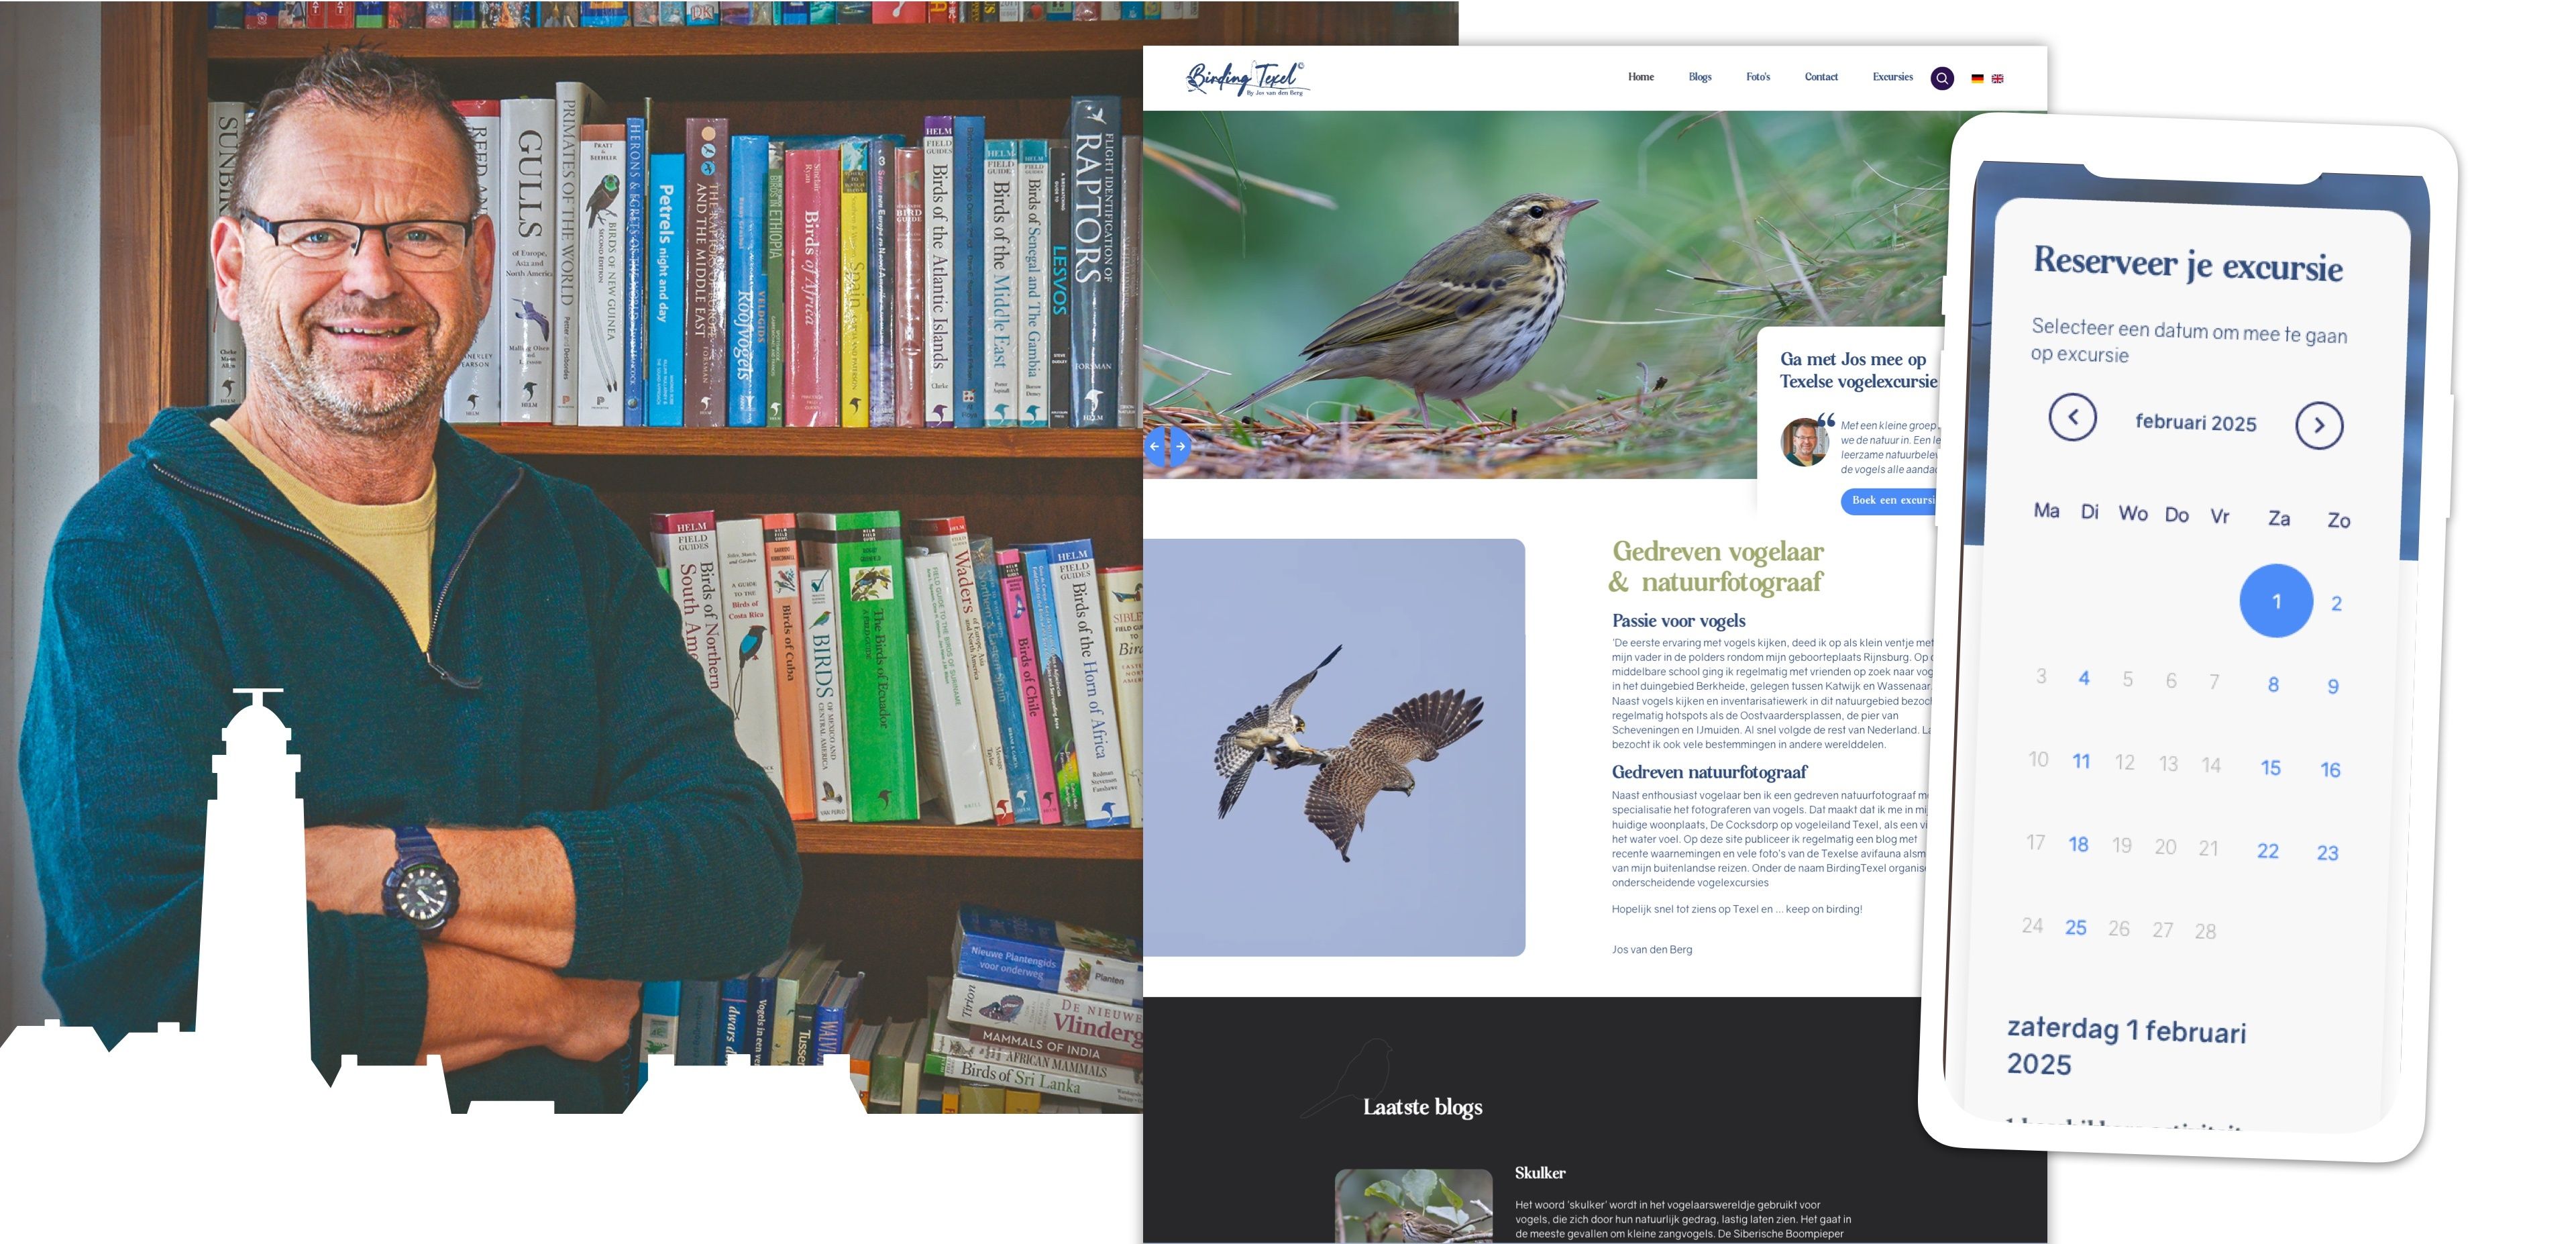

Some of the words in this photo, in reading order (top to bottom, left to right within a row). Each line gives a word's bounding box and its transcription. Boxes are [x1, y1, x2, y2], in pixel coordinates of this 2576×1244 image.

[1189, 62, 1252, 97] Birding
[1255, 62, 1297, 87] Texel
[1628, 72, 1655, 81] Home
[1689, 71, 1712, 84] Blogs
[1746, 71, 1771, 81] Foto's
[1805, 72, 1839, 81] Contact
[1873, 71, 1914, 81] Excursies
[563, 100, 576, 178] PRIMATES
[519, 129, 543, 238] GULLS
[562, 183, 575, 203] OF
[932, 164, 948, 203] Birds
[1028, 180, 1041, 210] Birds
[696, 184, 707, 214] AND
[994, 181, 1010, 223] Birds
[1075, 133, 1102, 282] RAPTORS
[561, 211, 575, 241] THE
[659, 185, 674, 244] Petrels
[932, 206, 948, 222] of
[1028, 213, 1041, 225] of
[608, 222, 616, 253] BIRDS
[696, 217, 706, 245] THE
[769, 210, 783, 259] ETHIOPIA
[805, 211, 819, 255] Birds
[932, 225, 948, 249] the
[994, 227, 1010, 243] of
[608, 256, 616, 268] OF
[657, 248, 669, 274] night
[994, 248, 1010, 269] the
[1025, 227, 1040, 272] Senegal
[561, 245, 574, 306] WORLD
[695, 250, 706, 302] MIDDLE
[802, 260, 818, 275] of
[2034, 244, 2179, 276] Reserveer
[2186, 248, 2212, 285] je
[2222, 253, 2344, 282] excursie
[608, 270, 616, 296] NEW
[659, 277, 668, 299] and
[932, 254, 948, 313] Atlantic
[1028, 276, 1040, 298] and
[1053, 246, 1067, 315] LESVOS
[657, 302, 668, 323] day
[802, 277, 818, 325] Africa
[994, 274, 1010, 331] Middle
[1028, 302, 1040, 327] The
[607, 299, 616, 341] GUINEA
[695, 306, 706, 338] EAST
[2031, 317, 2114, 337] Selecteer
[2118, 323, 2149, 338] een
[2155, 322, 2208, 340] datum
[2212, 326, 2239, 340] om
[2243, 327, 2281, 342] mee
[2285, 326, 2301, 343] te
[2305, 329, 2348, 347] gaan
[734, 291, 753, 380] Roofvogels
[932, 318, 948, 369] Islands
[994, 335, 1010, 368] East
[1028, 331, 1040, 378] Gambia
[1780, 351, 1803, 366] Ga
[1807, 352, 1837, 366] met
[1841, 352, 1866, 366] Jos
[1870, 356, 1903, 366] mee
[1908, 356, 1927, 370] op
[2031, 348, 2053, 364] op
[2057, 346, 2129, 364] excursie
[1779, 373, 1833, 388] Texelse
[1837, 373, 1938, 393] vogelexcursie
[2135, 413, 2206, 431] februari
[2212, 415, 2257, 432] 2025
[2035, 502, 2059, 518] Ma
[2082, 503, 2098, 519] Di
[2119, 505, 2148, 521] Wo
[2166, 507, 2189, 523] Do
[2211, 508, 2229, 523] Vr
[2269, 510, 2290, 526] Za
[2328, 512, 2350, 529] Zo
[1613, 539, 1722, 562] Gedreven
[1728, 539, 1825, 568] vogelaar
[680, 564, 700, 615] South
[700, 562, 715, 600] Birds
[955, 550, 974, 614] Waders
[1608, 570, 1629, 592] &
[1642, 570, 1825, 599] natuurfotograaf
[704, 605, 717, 620] of
[1073, 582, 1087, 618] Birds
[2273, 593, 2281, 609] 1
[2331, 595, 2343, 611] 2
[729, 613, 747, 621] Costa
[782, 605, 794, 636] Birds
[874, 608, 885, 631] The
[1078, 620, 1091, 634] of
[1613, 612, 1658, 628] Passie
[1660, 617, 1696, 628] voor
[1699, 613, 1746, 632] vogels
[706, 623, 719, 690] Northern
[785, 637, 794, 649] of
[875, 634, 886, 664] Birds
[1018, 637, 1030, 668] Birds
[1079, 636, 1093, 658] the
[785, 652, 796, 682] Cuba
[813, 634, 834, 698] BIRDS
[879, 667, 888, 680] of
[1024, 672, 1033, 683] of
[1084, 660, 1097, 696] Horn
[877, 681, 890, 729] Ecuador
[1026, 686, 1038, 717] Chile
[1090, 701, 1104, 715] of
[1091, 719, 1108, 759] Africa
[1612, 764, 1684, 779] Gedreven
[1688, 764, 1809, 784] natuurfotograaf
[1612, 878, 1695, 887] onderscheidende
[1697, 878, 1769, 889] vogelexcursies
[1612, 904, 1652, 916] Hopelijk
[1654, 904, 1674, 914] snel
[1676, 904, 1690, 914] tot
[1691, 904, 1717, 914] ziens
[1718, 906, 1731, 916] op
[1733, 904, 1759, 914] Texel
[1786, 904, 1810, 916] keep
[1826, 904, 1862, 916] birding!
[971, 946, 1004, 960] Nieuwe
[1006, 951, 1057, 969] Plantengids
[1612, 945, 1629, 954] Jos
[1650, 945, 1668, 954] den
[1670, 945, 1693, 956] Berg
[980, 962, 999, 971] voor
[1001, 964, 1043, 980] onderweg
[1062, 998, 1079, 1013] DE
[1087, 1006, 1142, 1023] NIEUWE
[2007, 1015, 2119, 1046] zaterdag
[2126, 1019, 2138, 1041] 1
[2145, 1019, 2246, 1044] februari
[983, 1031, 1042, 1050] MAMMALS
[1047, 1041, 1063, 1053] OF
[1067, 1045, 1100, 1059] INDIA
[962, 1061, 997, 1082] Birds
[999, 1068, 1013, 1082] of
[1014, 1071, 1035, 1087] Sri
[1040, 1074, 1081, 1094] Lanka
[1006, 1051, 1049, 1068] AFRICAN
[1053, 1059, 1107, 1078] MAMMALS
[2007, 1052, 2072, 1076] 2025
[1364, 1098, 1430, 1116] Laatste
[1434, 1097, 1483, 1121] blogs
[1515, 1165, 1566, 1180] Skulker
